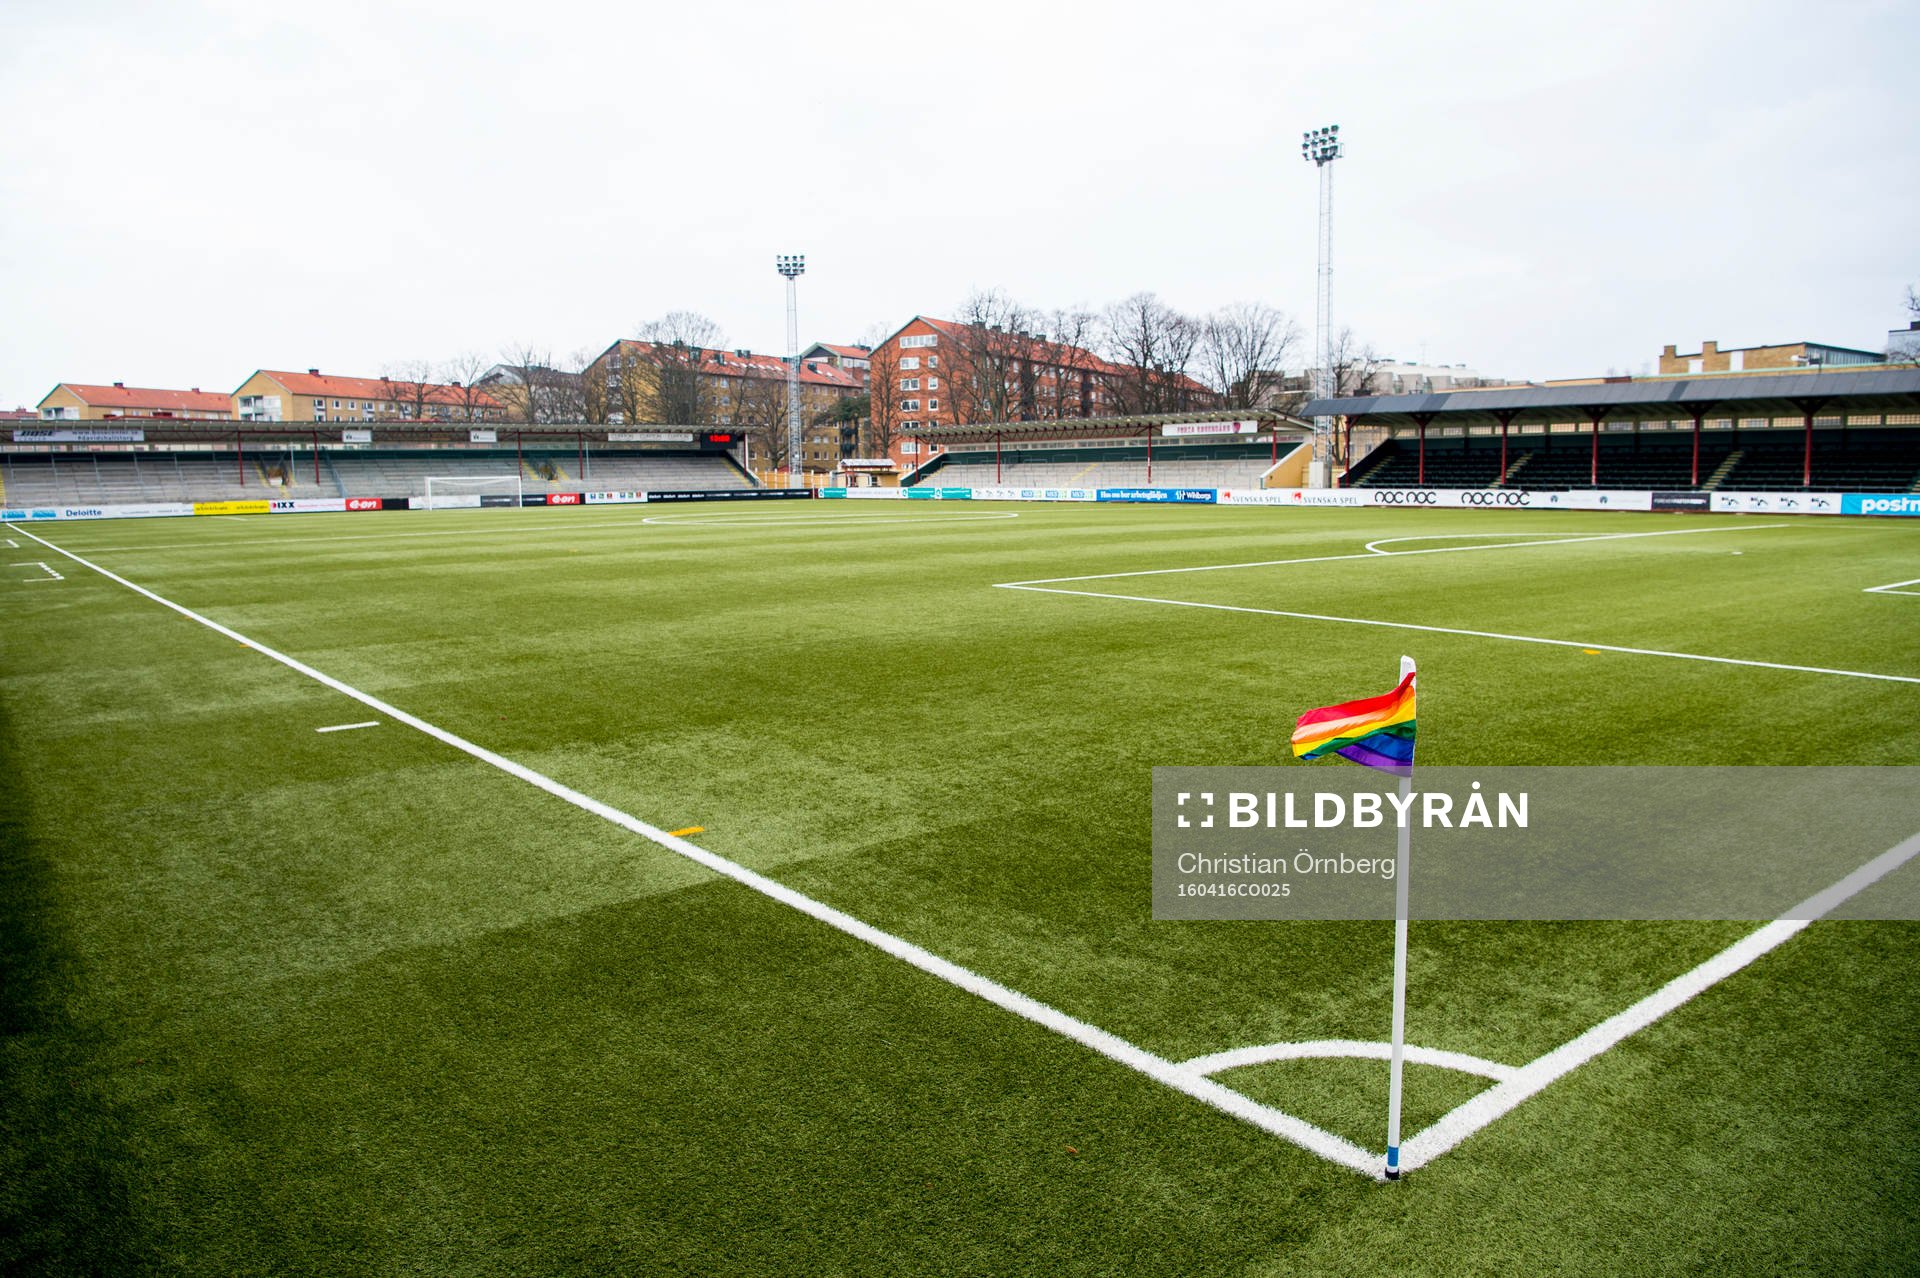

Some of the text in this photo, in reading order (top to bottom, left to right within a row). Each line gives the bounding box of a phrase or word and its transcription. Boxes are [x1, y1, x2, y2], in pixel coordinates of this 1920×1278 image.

[1303, 496, 1358, 504] SVENSKA SPEL
[66, 509, 102, 517] Deloitte
